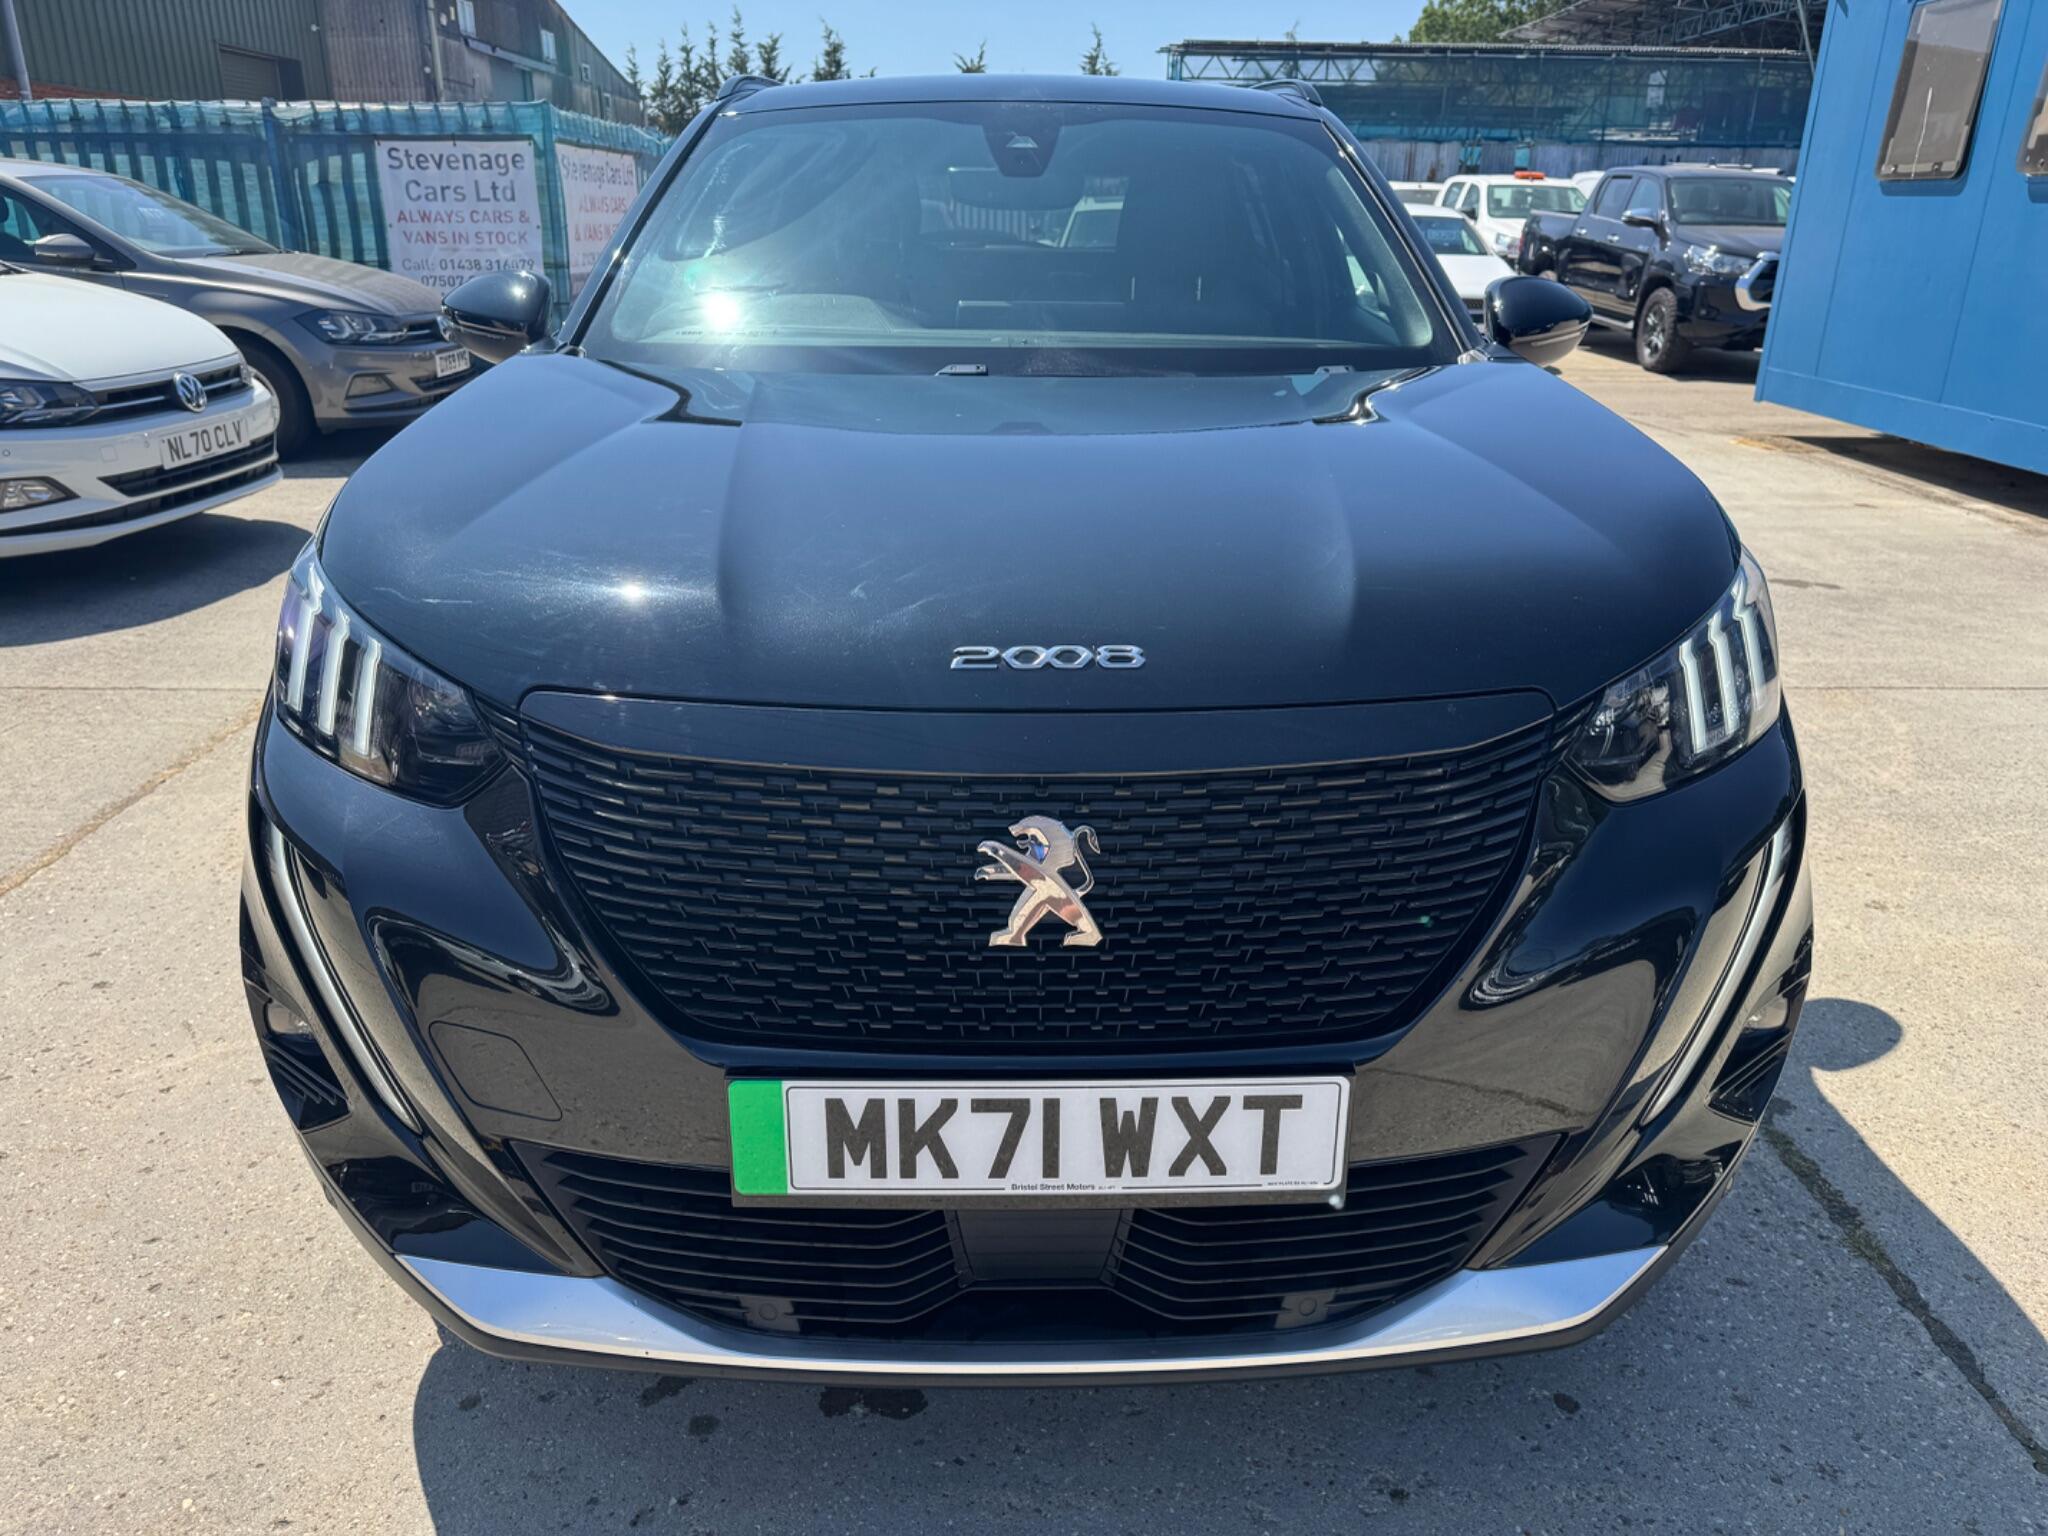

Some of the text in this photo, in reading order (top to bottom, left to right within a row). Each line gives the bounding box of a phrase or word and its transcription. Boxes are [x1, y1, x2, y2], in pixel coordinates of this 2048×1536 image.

[387, 147, 525, 176] Stevenage
[405, 180, 516, 202] Cars Ltd
[396, 209, 530, 224] ALWAYS CARS &
[402, 231, 528, 245] VANS IN STOCK
[401, 258, 435, 271] Call:
[439, 259, 482, 271] 01438
[167, 429, 212, 463] NL70
[950, 645, 1146, 669] 2008
[824, 1095, 1302, 1179] MK71 WXT
[1067, 1183, 1095, 1191] Motors
